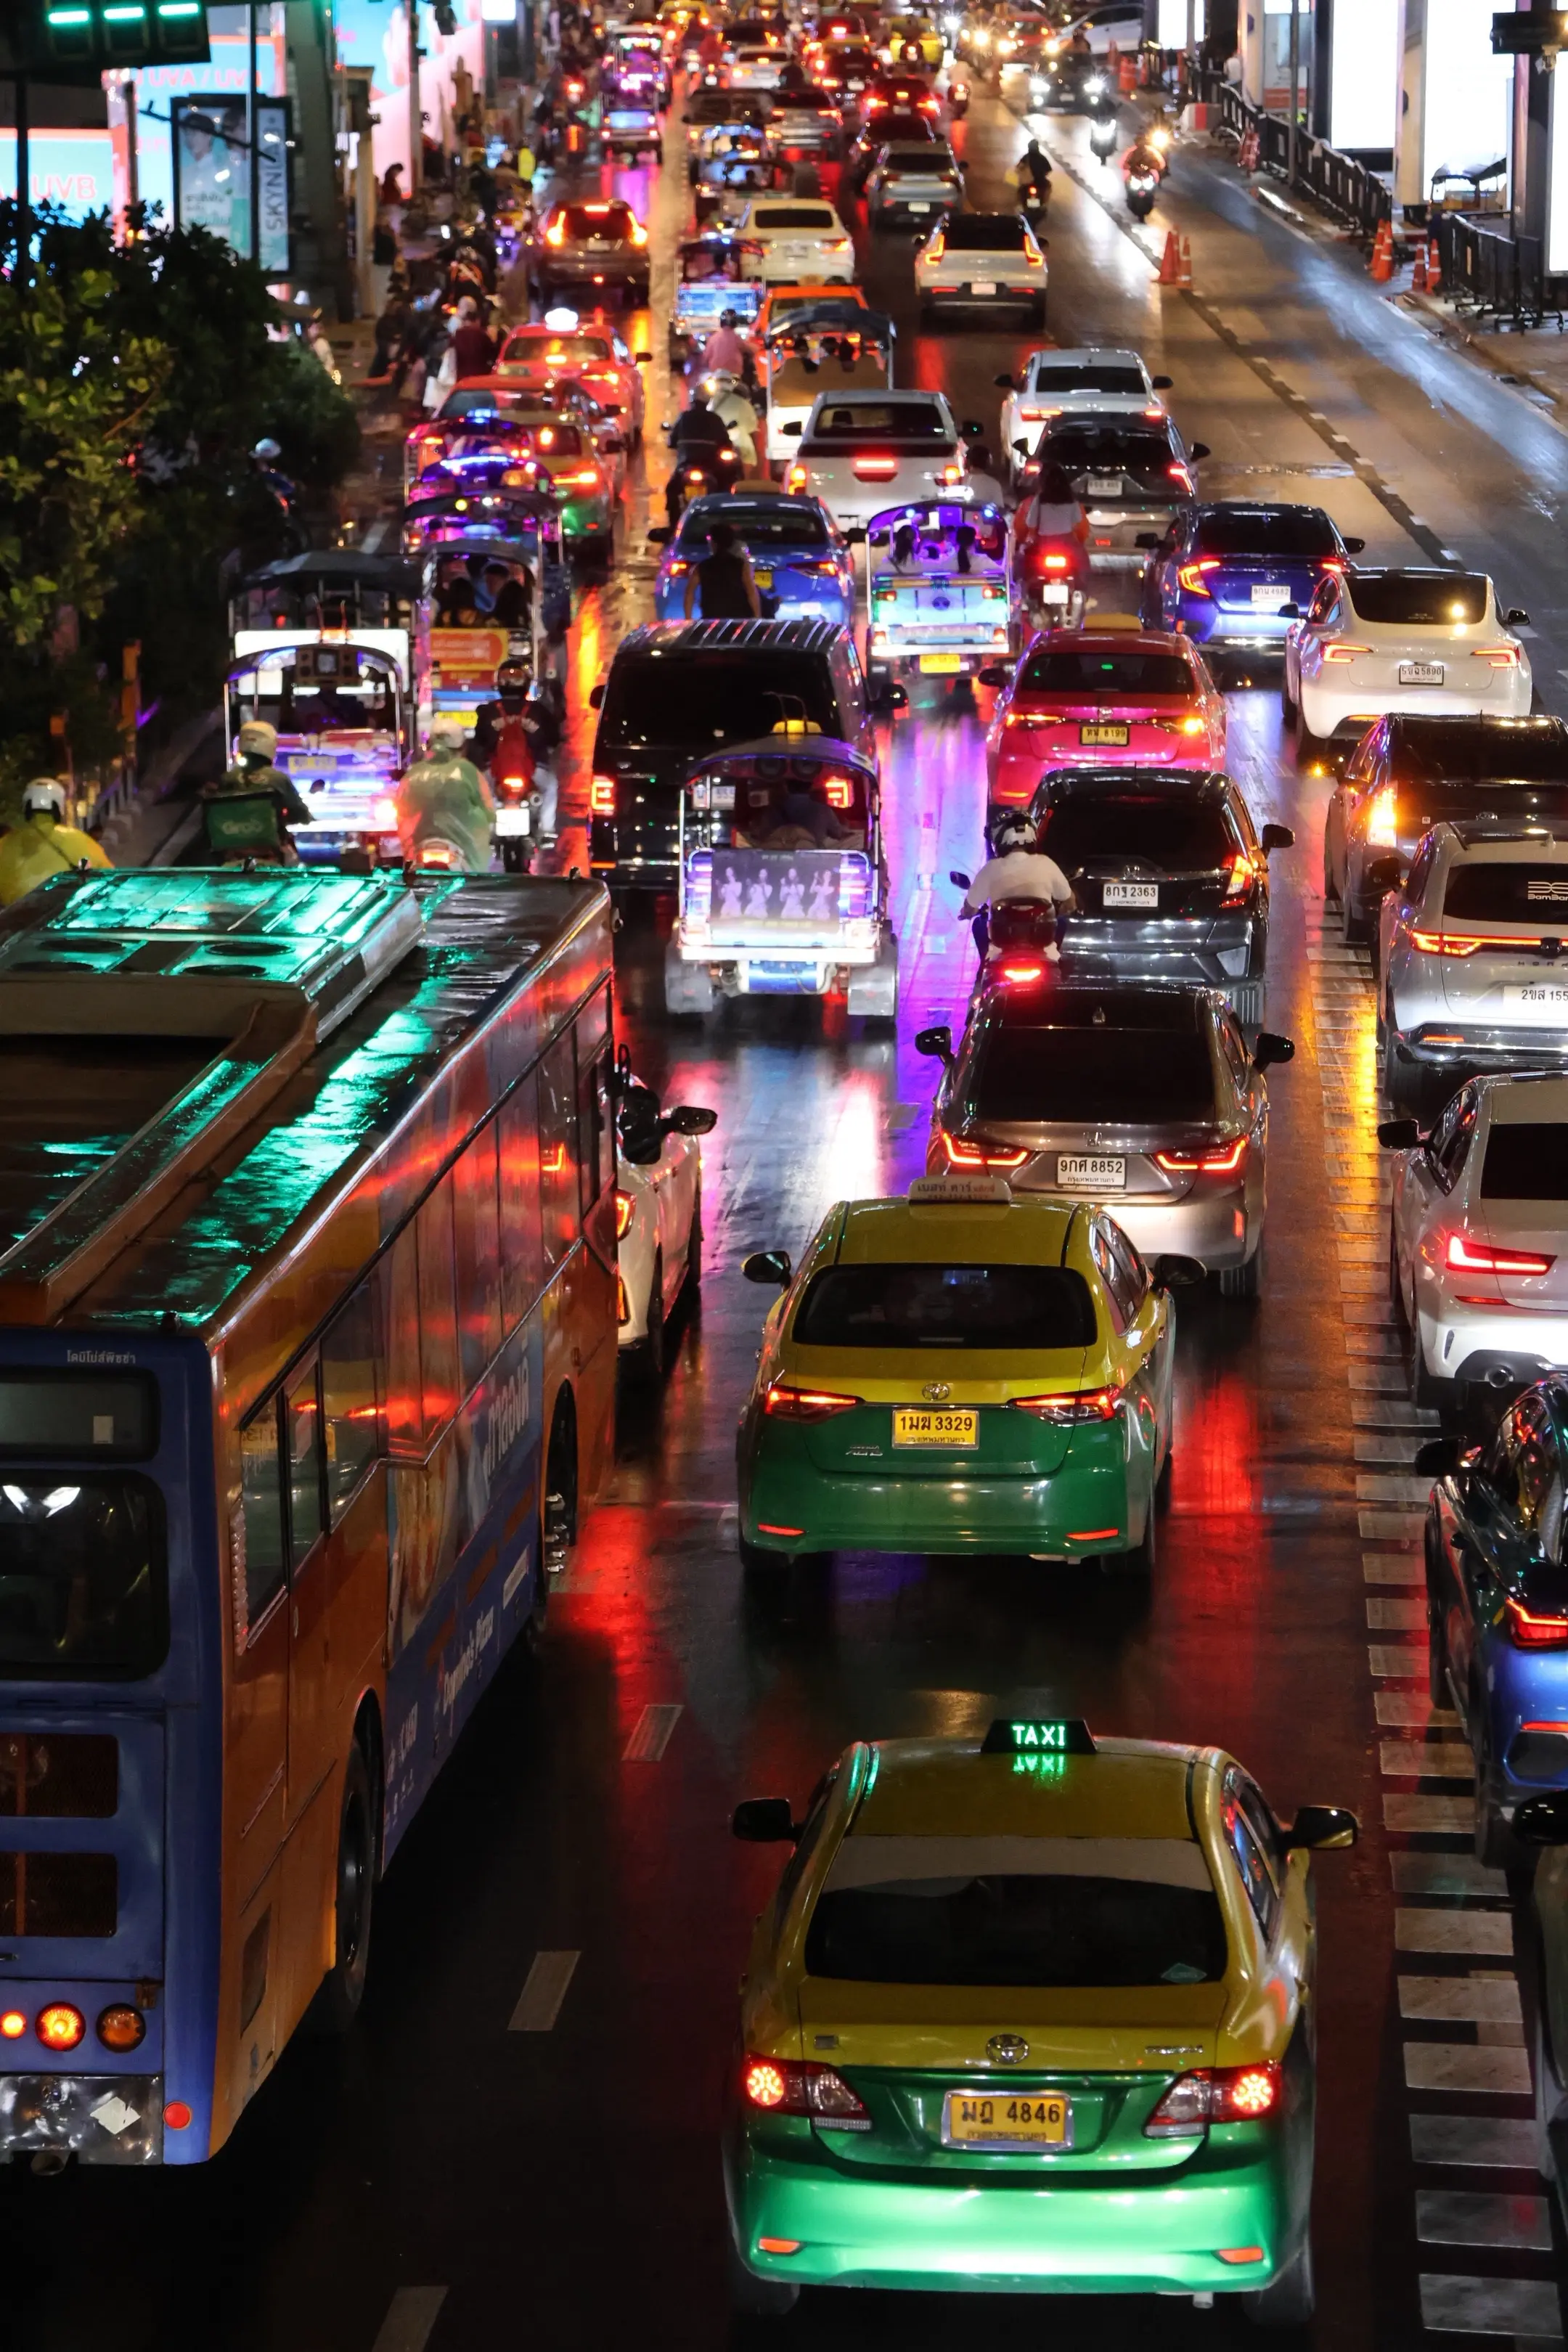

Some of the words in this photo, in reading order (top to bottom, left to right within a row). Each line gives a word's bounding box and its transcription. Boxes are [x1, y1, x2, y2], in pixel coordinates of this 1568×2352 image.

[150, 68, 196, 87] UVA
[30, 174, 97, 200] UVB
[1130, 886, 1156, 898] 2363
[1061, 1159, 1087, 1172] 9กศ
[1091, 1160, 1123, 1174] 8852
[935, 1416, 973, 1432] 3329
[1012, 1725, 1066, 1746] TAXI
[1007, 2100, 1061, 2126] 4846
